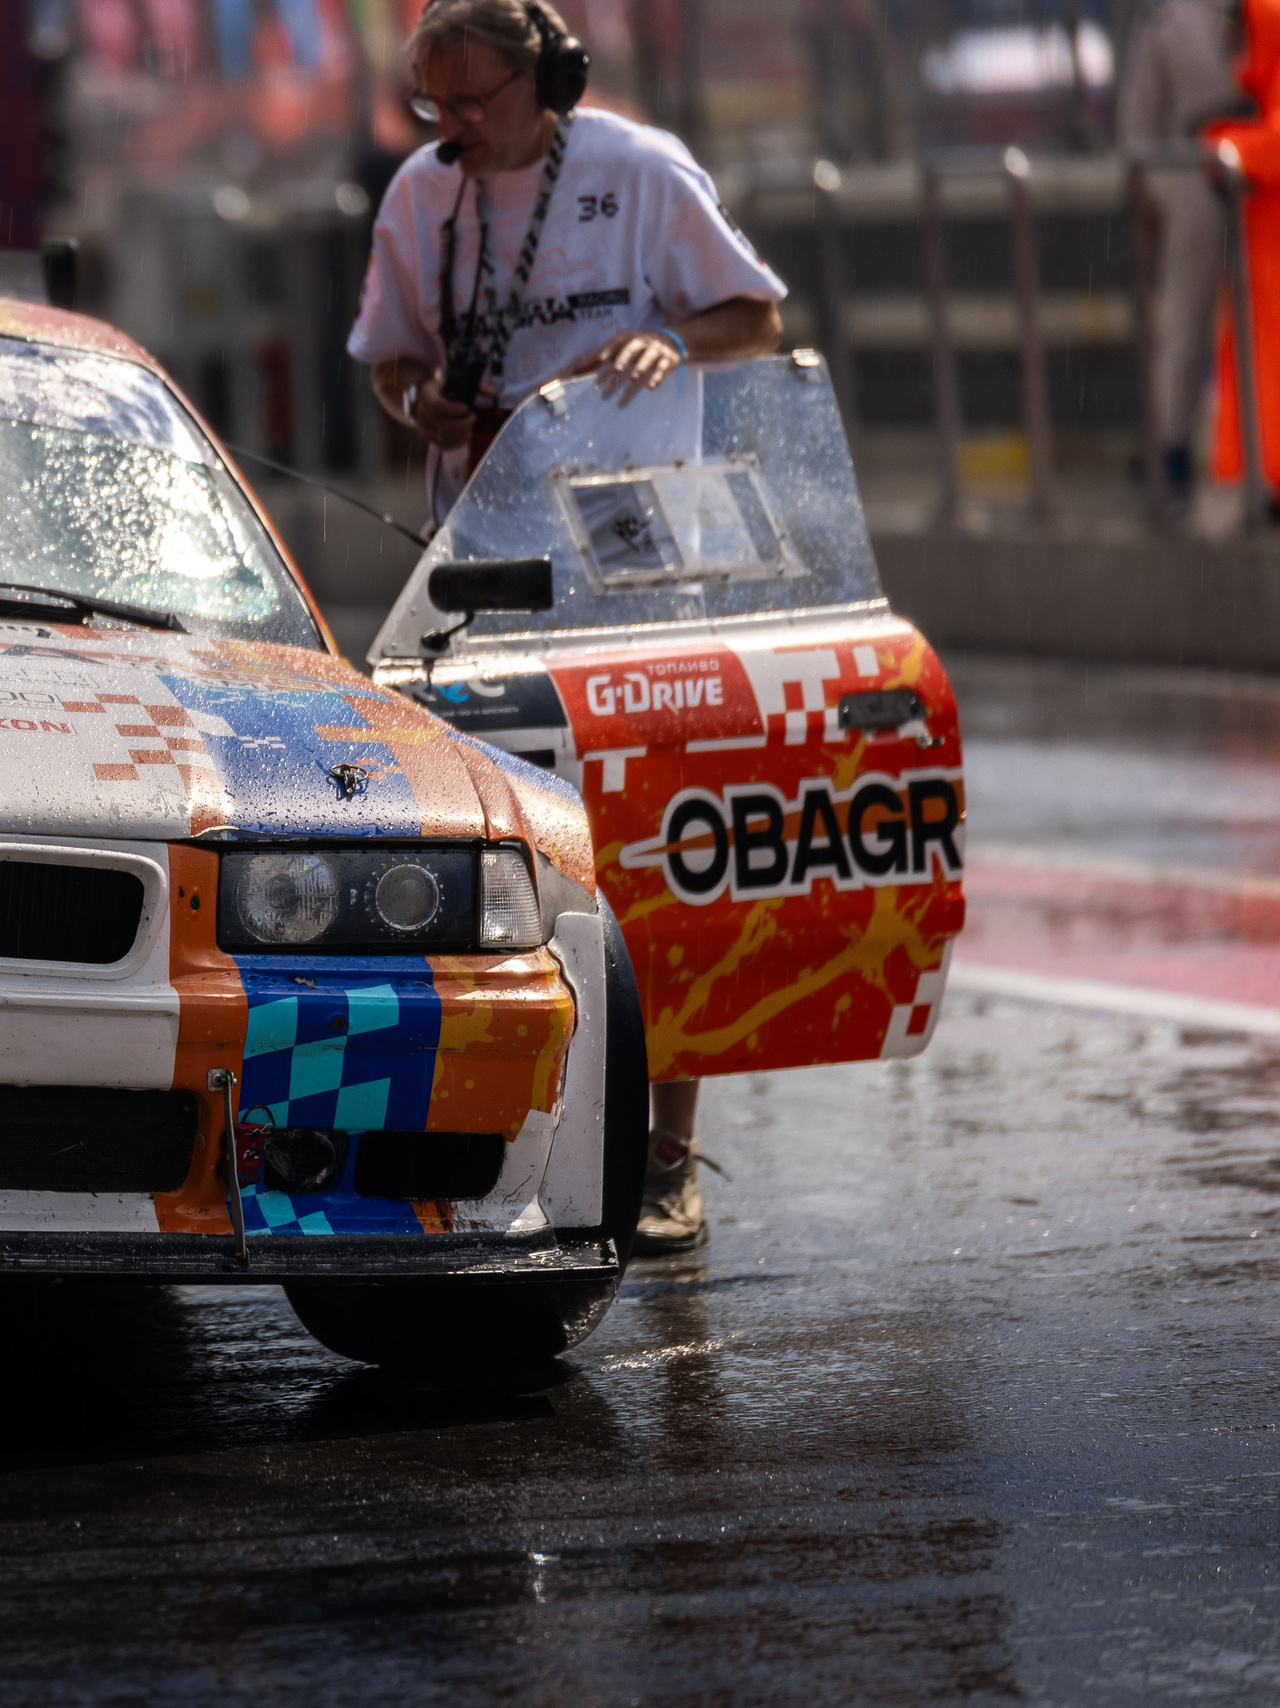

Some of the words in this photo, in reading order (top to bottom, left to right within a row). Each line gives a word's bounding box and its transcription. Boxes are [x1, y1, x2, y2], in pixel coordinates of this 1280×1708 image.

[578, 192, 619, 222] 36
[646, 658, 720, 676] ТОПЛИВО
[667, 778, 963, 895] OBAGR
